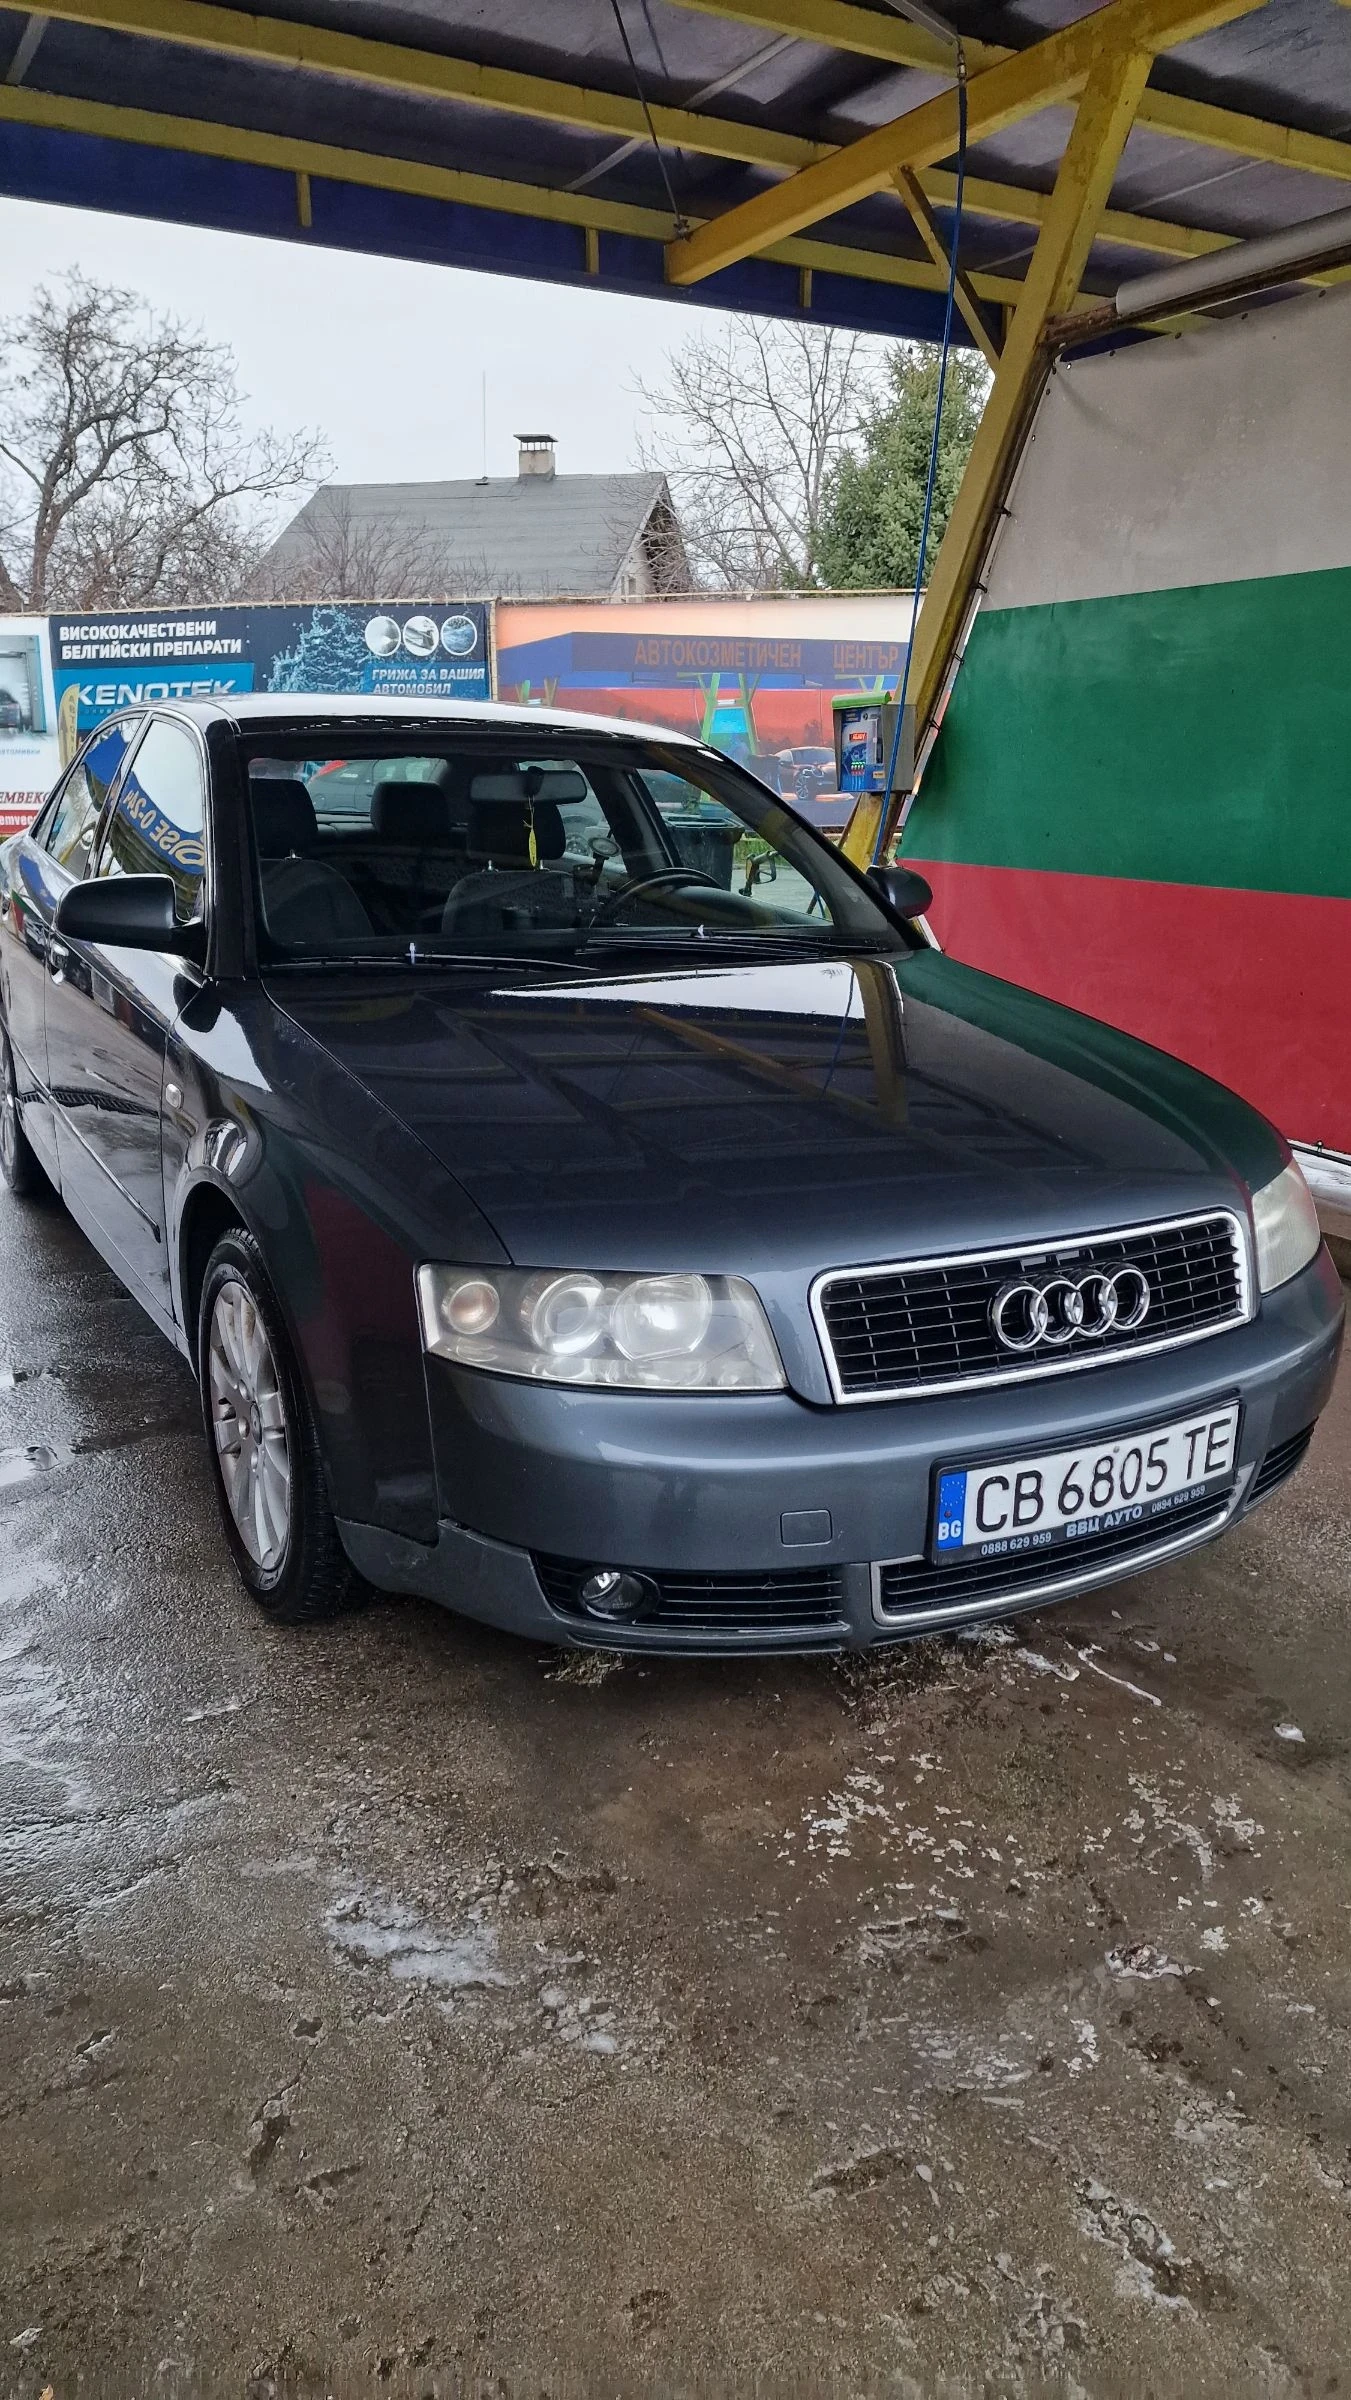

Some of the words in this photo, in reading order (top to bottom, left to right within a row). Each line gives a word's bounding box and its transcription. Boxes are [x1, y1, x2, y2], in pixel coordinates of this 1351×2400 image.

[59, 621, 217, 641] ВИСОКОКАЧЕСТВЕНИ
[62, 641, 151, 659] БЕЛГИЙСКИ
[153, 639, 242, 657] ПРЕПАРАТИ
[634, 640, 801, 668] АВТОКОЗМЕТИЧЕН
[833, 644, 899, 670] ЦЕНТЪР
[372, 669, 418, 681] ГРИЖА
[420, 668, 437, 680] ЗА
[440, 667, 485, 680] ВАШИЯ
[77, 679, 236, 706] KENOTEK
[373, 683, 452, 695] АВТОМОБИЛ
[975, 1470, 1045, 1533] CB
[1058, 1438, 1170, 1515] 6805
[1184, 1417, 1232, 1480] TE
[1151, 1499, 1172, 1513] 0894
[1173, 1492, 1189, 1506] 629
[1190, 1485, 1206, 1499] 959
[1104, 1504, 1143, 1528] АУТО
[938, 1519, 962, 1541] BG
[981, 1541, 1008, 1555] 0888
[1009, 1537, 1030, 1550] 629
[1032, 1532, 1052, 1546] 959
